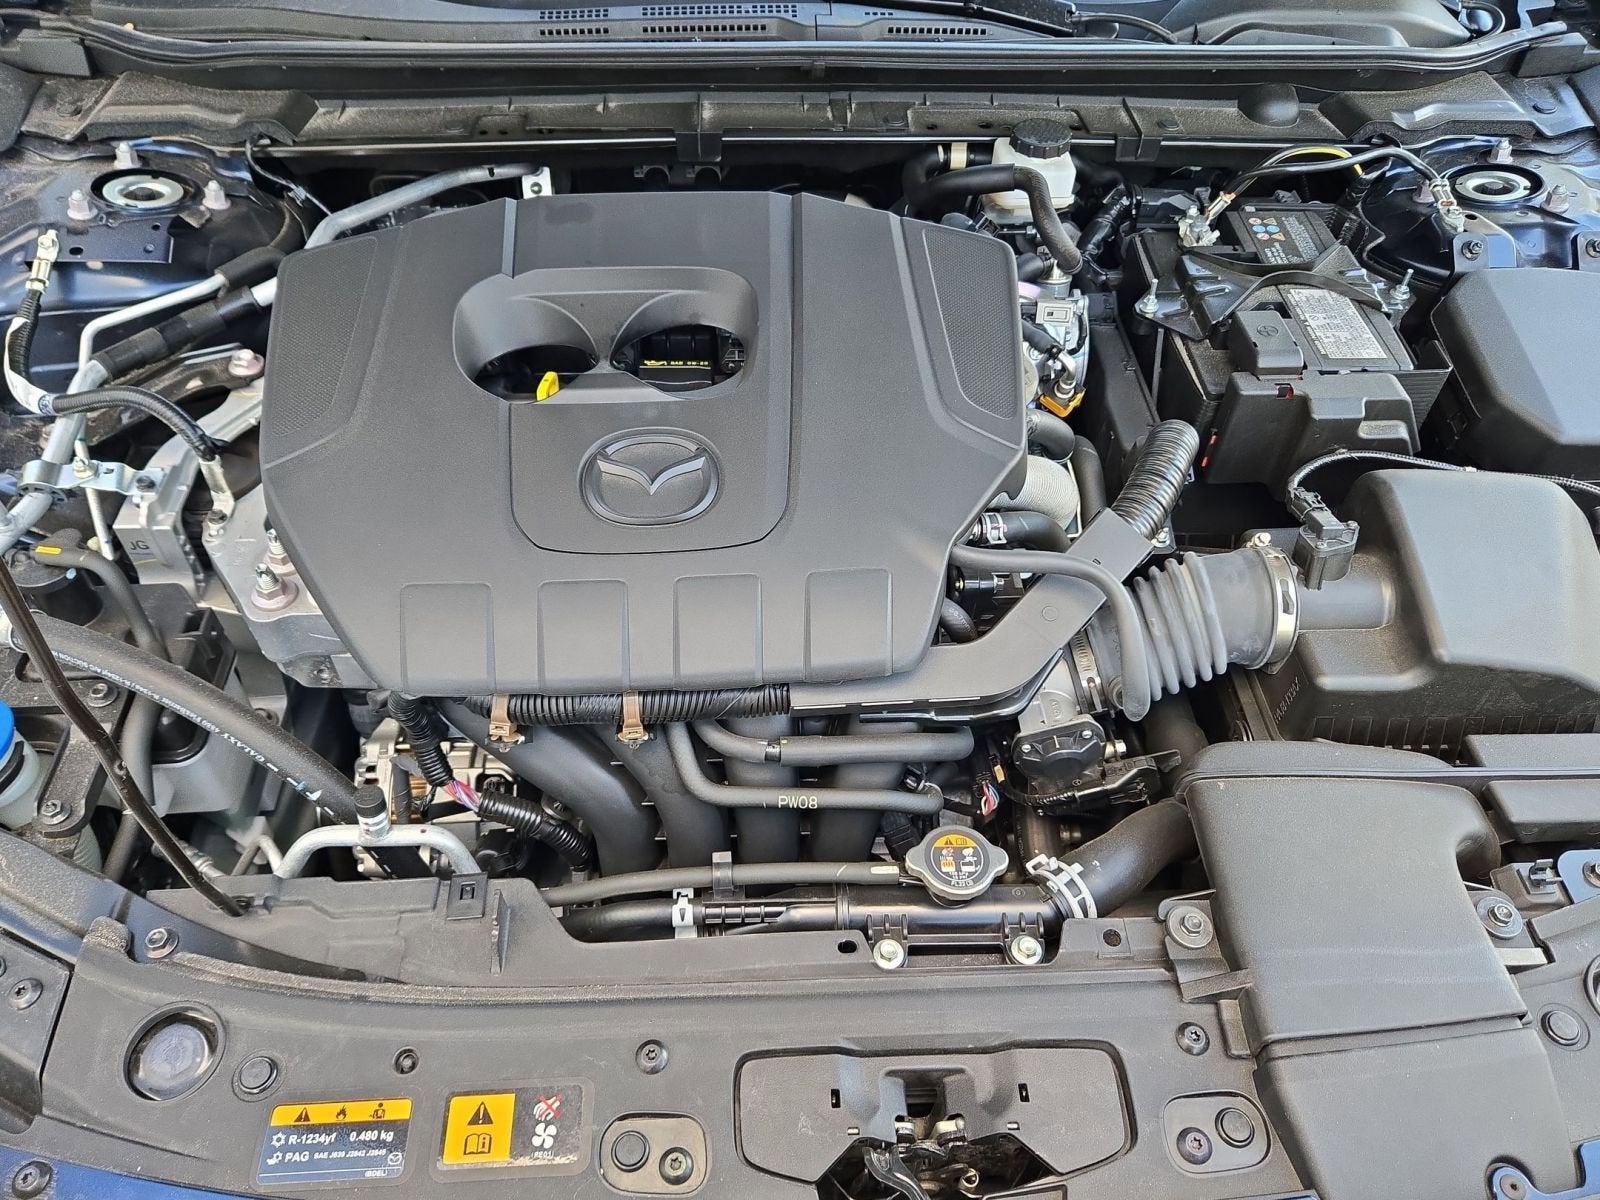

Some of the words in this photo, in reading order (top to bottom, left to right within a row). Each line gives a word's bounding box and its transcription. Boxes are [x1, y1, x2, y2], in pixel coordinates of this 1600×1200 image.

[222, 732, 265, 763] GALAXY
[778, 795, 818, 809] PW08
[288, 1132, 337, 1145] R-1234yf
[350, 1130, 377, 1142] 0.480
[380, 1129, 394, 1142] kg
[284, 1151, 310, 1162] PAG
